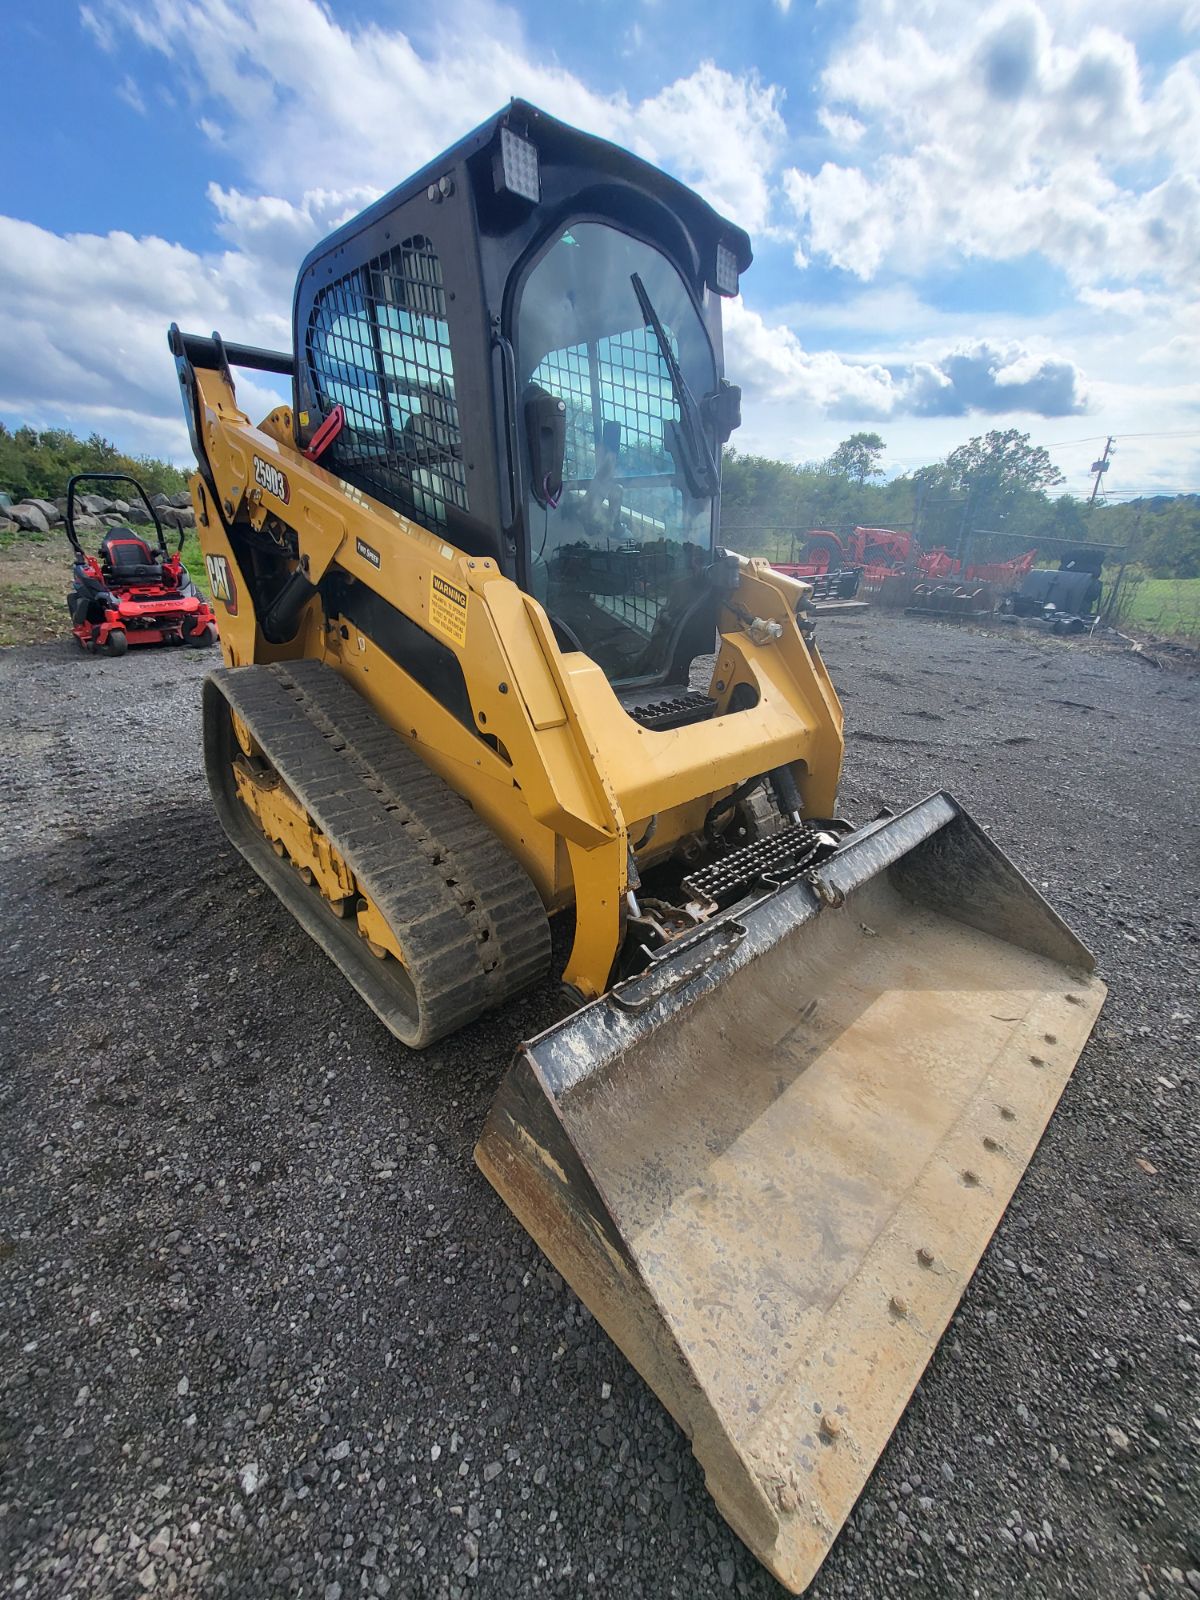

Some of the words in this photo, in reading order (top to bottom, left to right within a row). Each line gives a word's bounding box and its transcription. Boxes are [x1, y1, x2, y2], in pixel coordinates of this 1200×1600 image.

[254, 456, 285, 500] 259D3
[206, 555, 232, 601] CAT
[434, 577, 466, 607] WARNING
